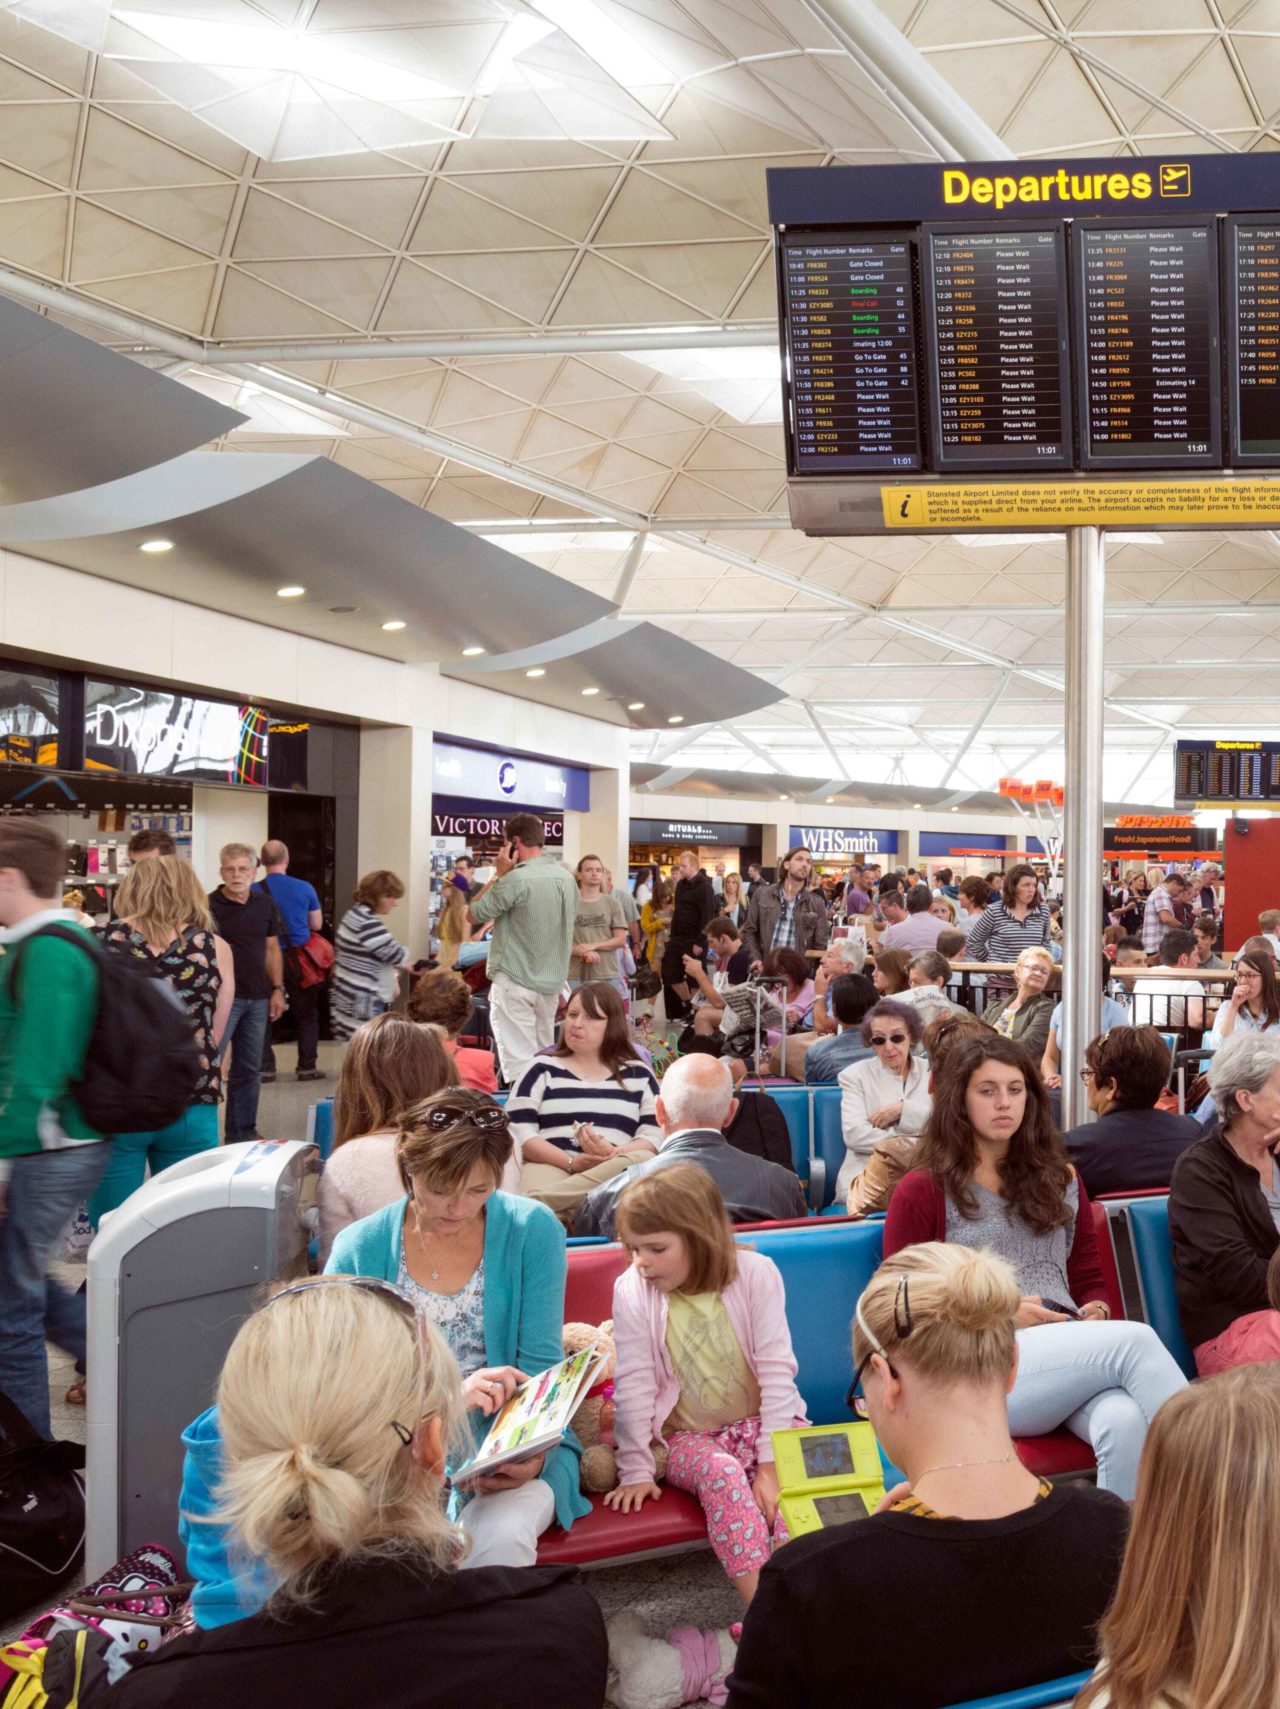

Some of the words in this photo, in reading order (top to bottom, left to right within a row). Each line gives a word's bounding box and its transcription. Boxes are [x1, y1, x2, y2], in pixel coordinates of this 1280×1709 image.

[943, 169, 1152, 209] Departures
[963, 490, 988, 498] Airport
[1232, 486, 1250, 494] flight
[928, 498, 948, 506] which
[962, 498, 993, 506] supplied
[1104, 496, 1129, 504] airport
[1133, 496, 1163, 504] accepts
[1223, 495, 1236, 503] any
[1168, 504, 1184, 512] may
[800, 829, 879, 853] WHSmith
